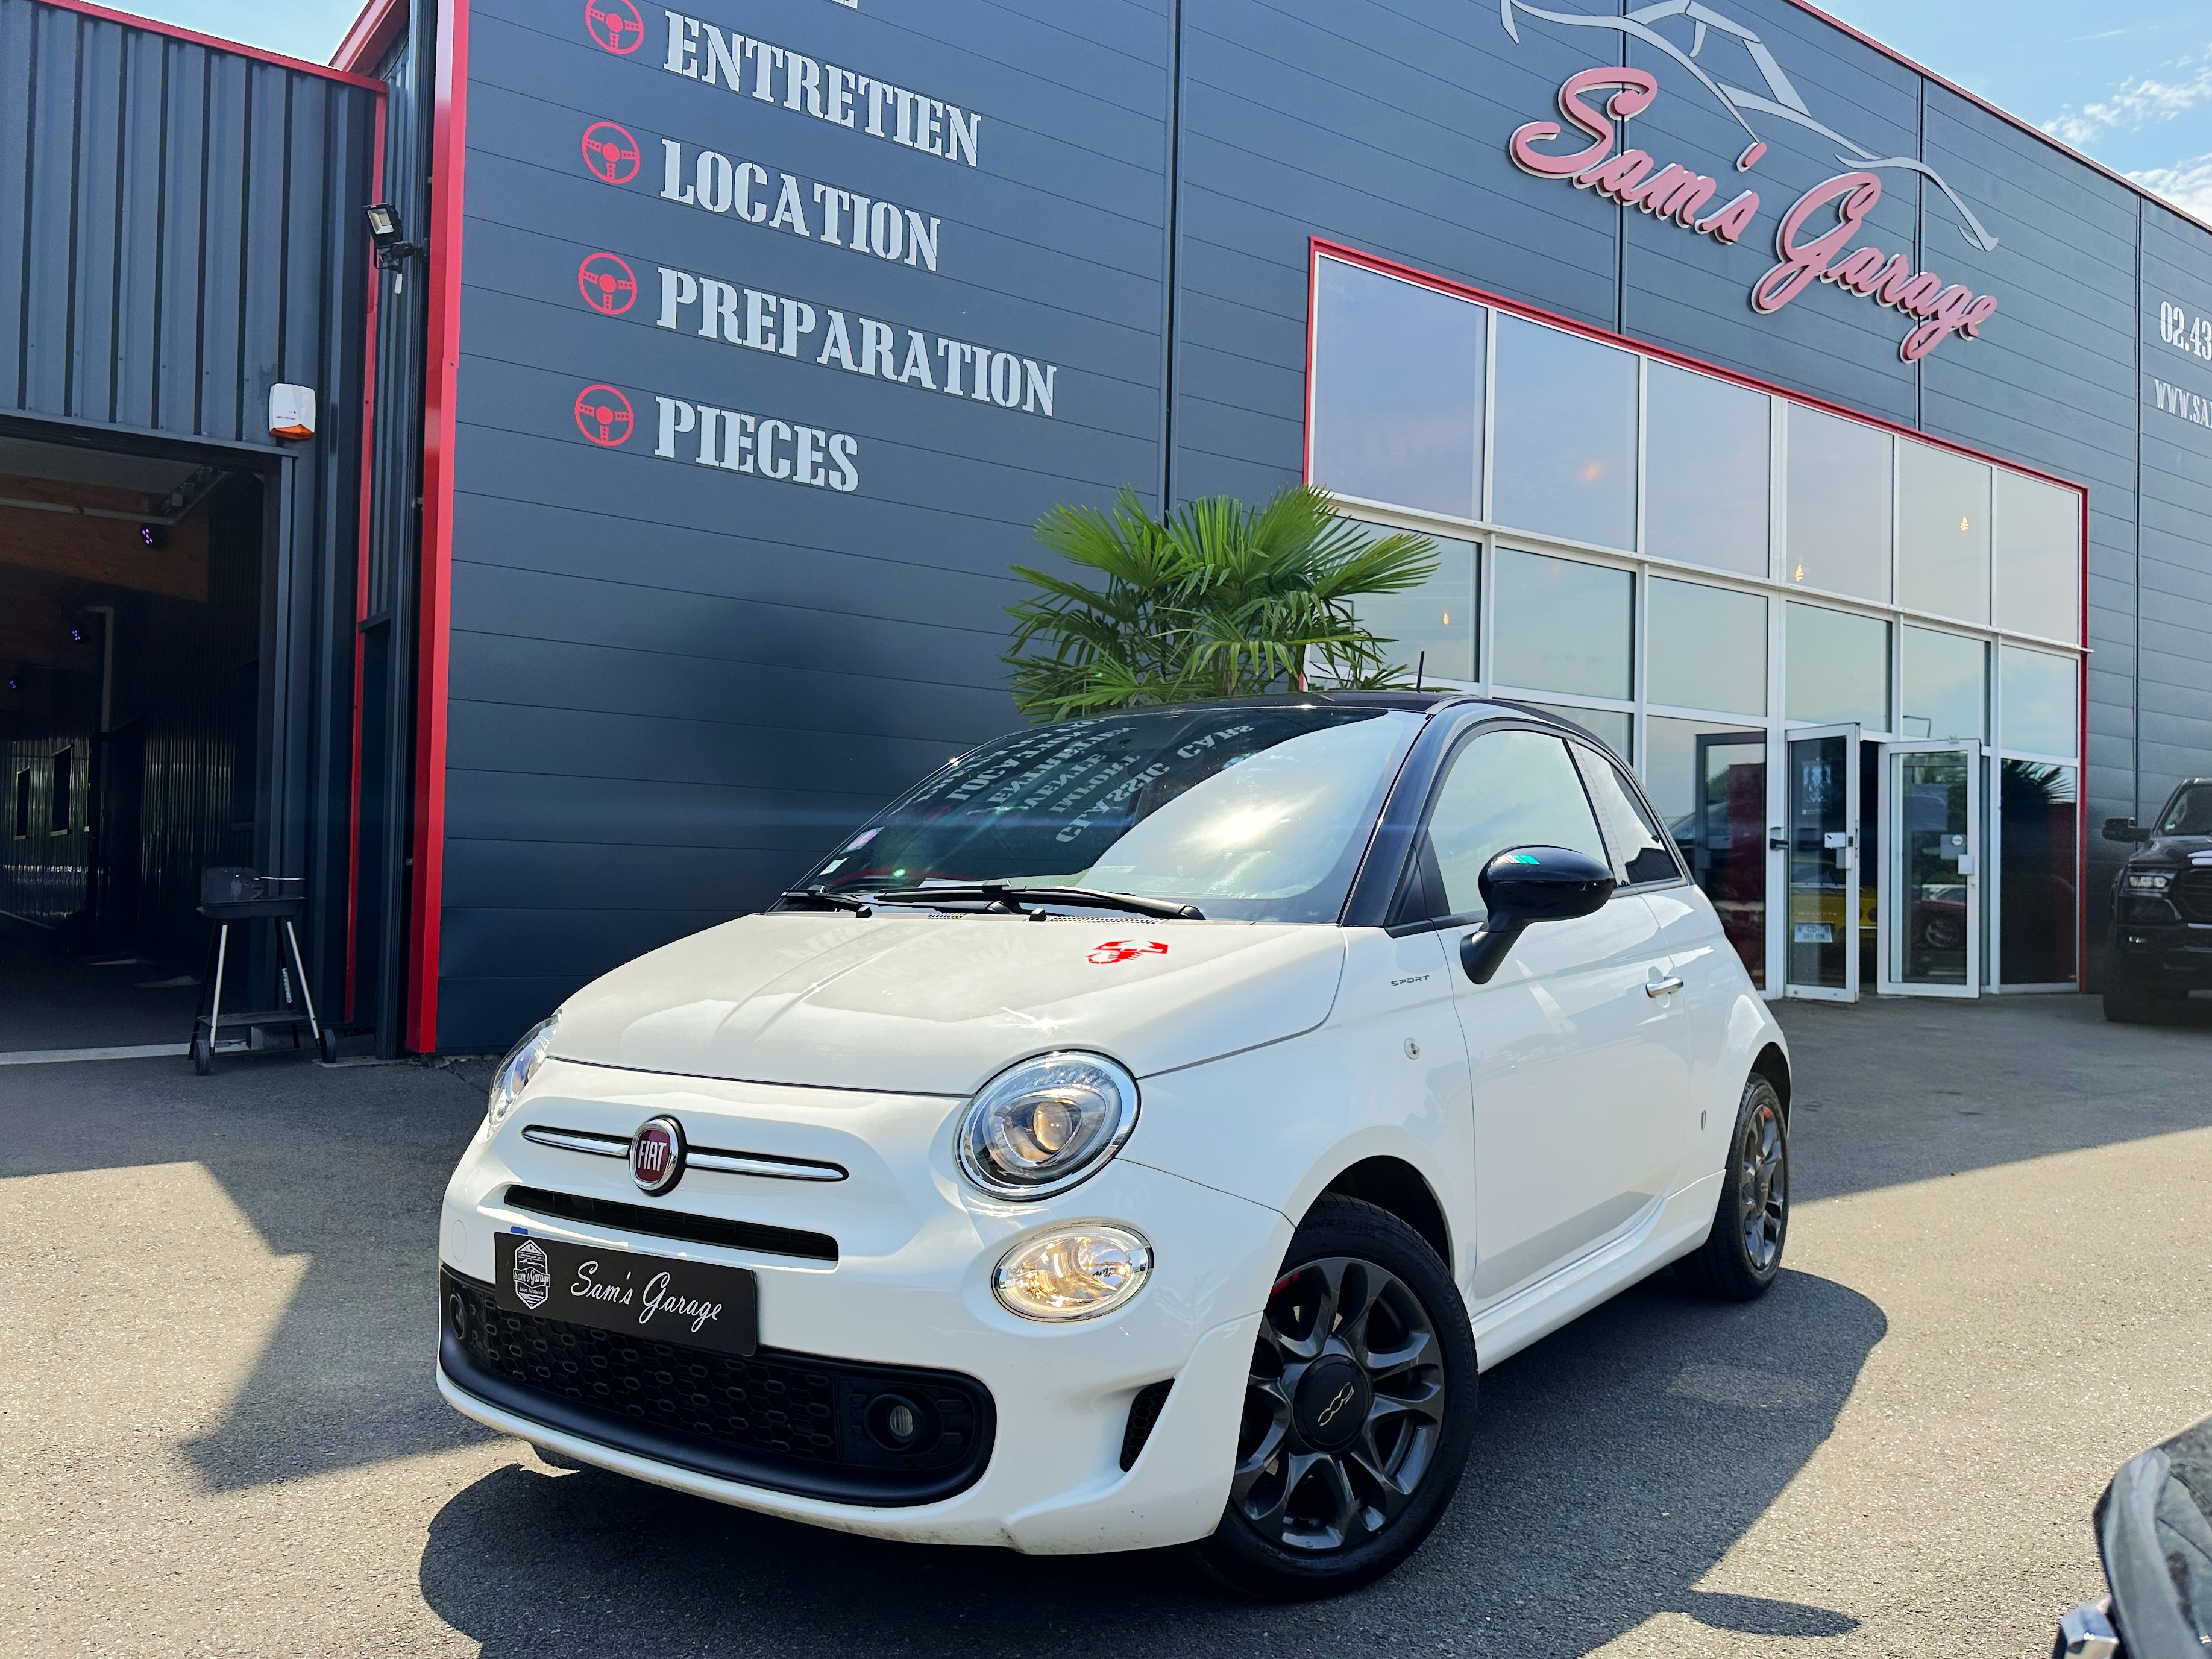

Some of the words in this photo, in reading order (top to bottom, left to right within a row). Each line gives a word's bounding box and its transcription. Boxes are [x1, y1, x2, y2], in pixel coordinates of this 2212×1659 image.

[663, 10, 981, 168] ENTRETIEN
[659, 138, 941, 272] LOCATION
[1509, 66, 1768, 245] Sam's
[1752, 172, 1998, 364] Garage
[656, 266, 1057, 417] PREPARATION
[2159, 301, 2211, 361] 02.43
[653, 395, 859, 493] PIECES
[2153, 378, 2211, 429] WWW.SA
[1390, 975, 1430, 986] SPORT
[637, 1140, 667, 1171] FIAT
[570, 1260, 633, 1305] Sam's
[638, 1271, 723, 1333] Garage
